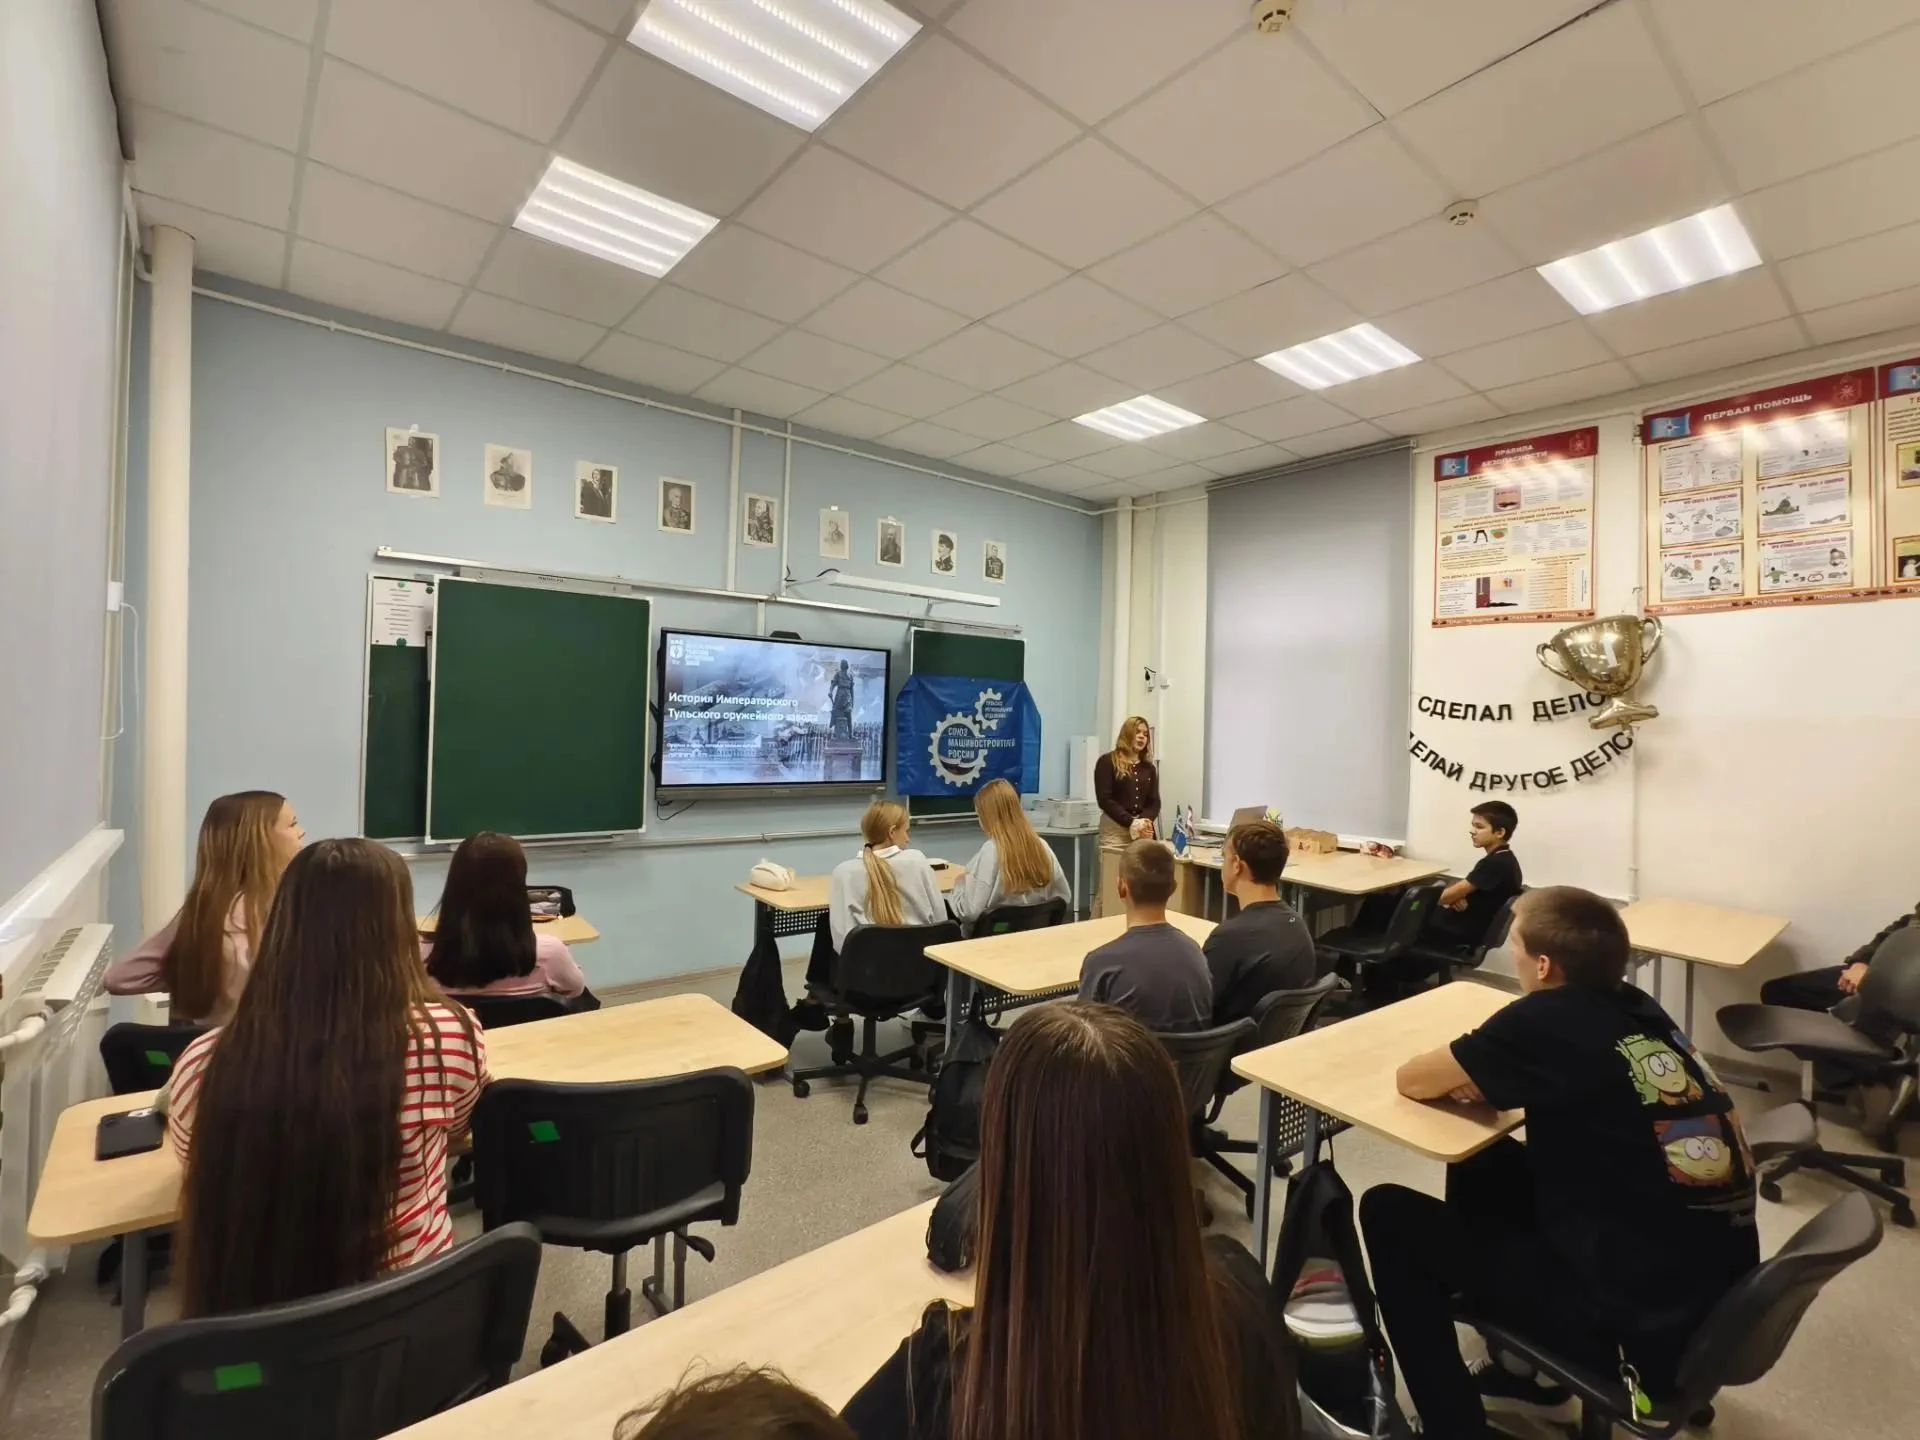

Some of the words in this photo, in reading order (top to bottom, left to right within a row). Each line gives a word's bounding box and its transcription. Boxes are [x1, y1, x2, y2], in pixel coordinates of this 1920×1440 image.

[1703, 406, 1751, 421] ПЕРВАЯ
[1754, 394, 1812, 411] ПОМОЩЬ
[1495, 445, 1534, 457] ПРАВИЛА
[668, 692, 713, 705] История
[716, 694, 799, 708] Императорского
[1418, 696, 1512, 721] СДЕЛАЛ
[1532, 691, 1606, 721] ДЕЛО
[668, 708, 720, 721] Тульского
[723, 711, 784, 721] оружейного
[948, 750, 975, 758] РОССИИ
[1409, 731, 1464, 782] ЕЛАЙ
[1468, 766, 1568, 792] ДРУГОЕ
[1570, 732, 1633, 781] ДЕЛО
